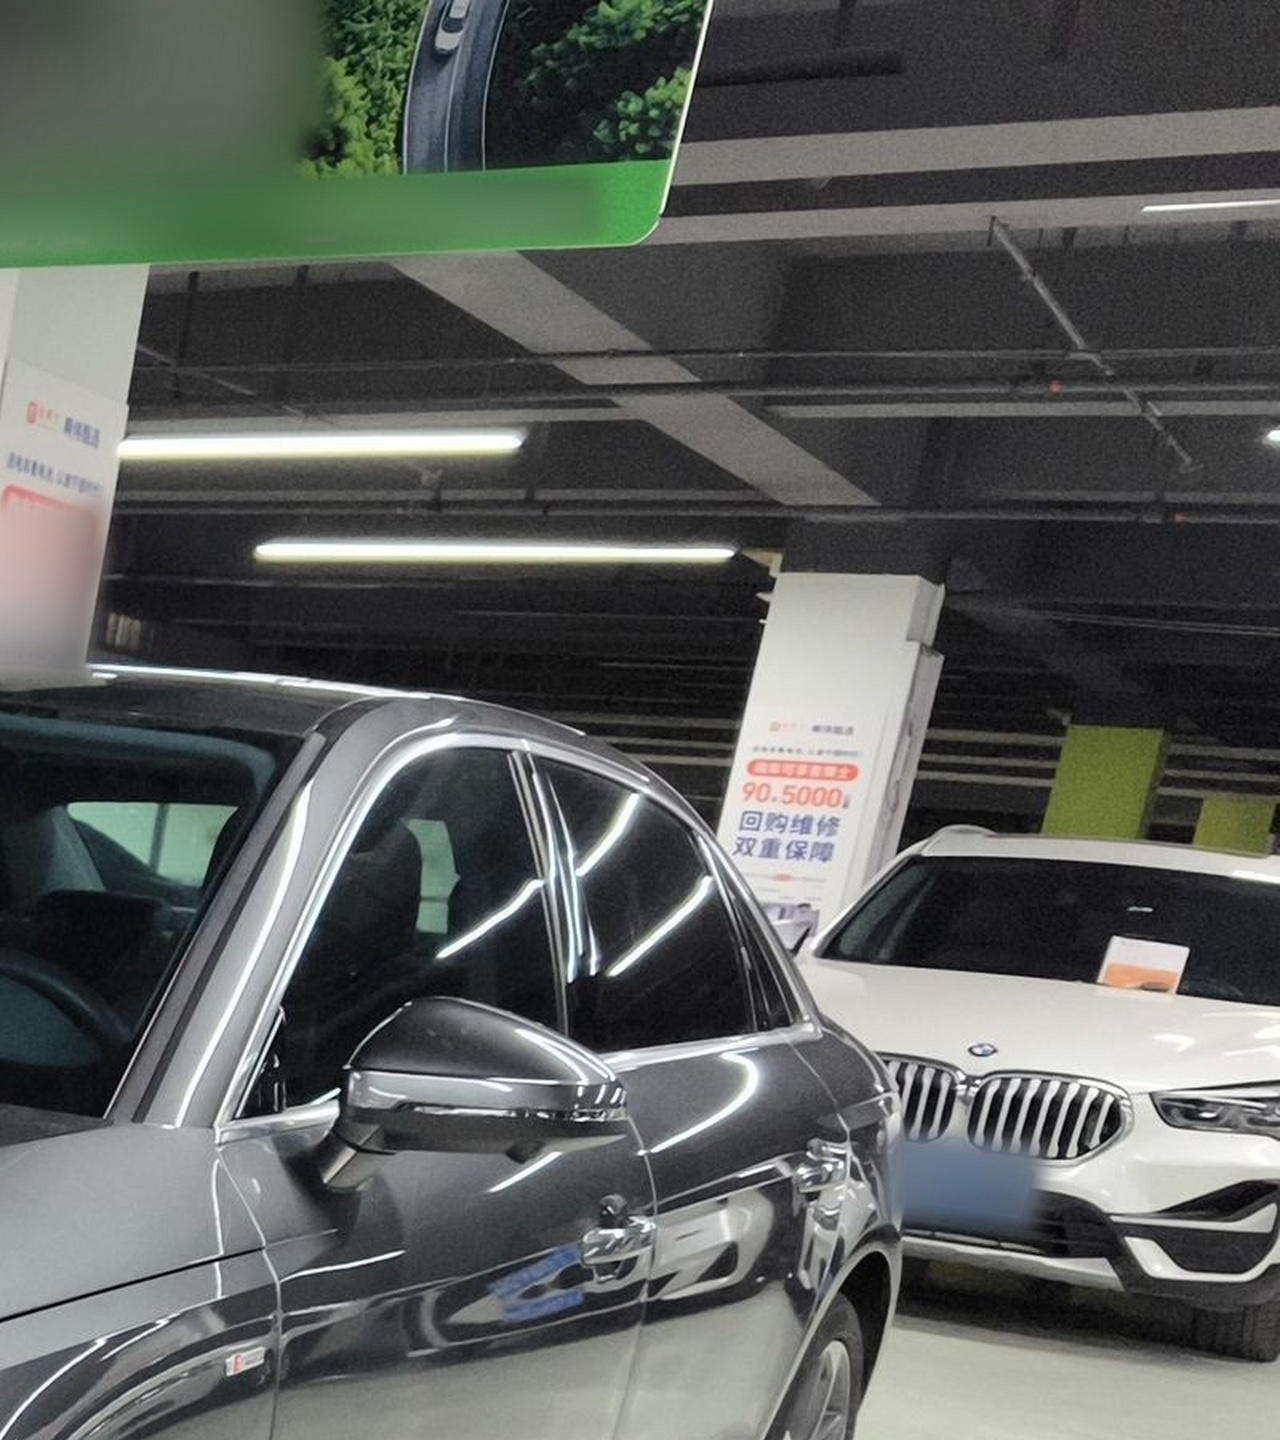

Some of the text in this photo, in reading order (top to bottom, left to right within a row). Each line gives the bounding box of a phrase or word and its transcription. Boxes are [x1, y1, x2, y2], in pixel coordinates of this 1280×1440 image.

[739, 809, 840, 837] 回购维修
[732, 837, 835, 862] 双重保障
